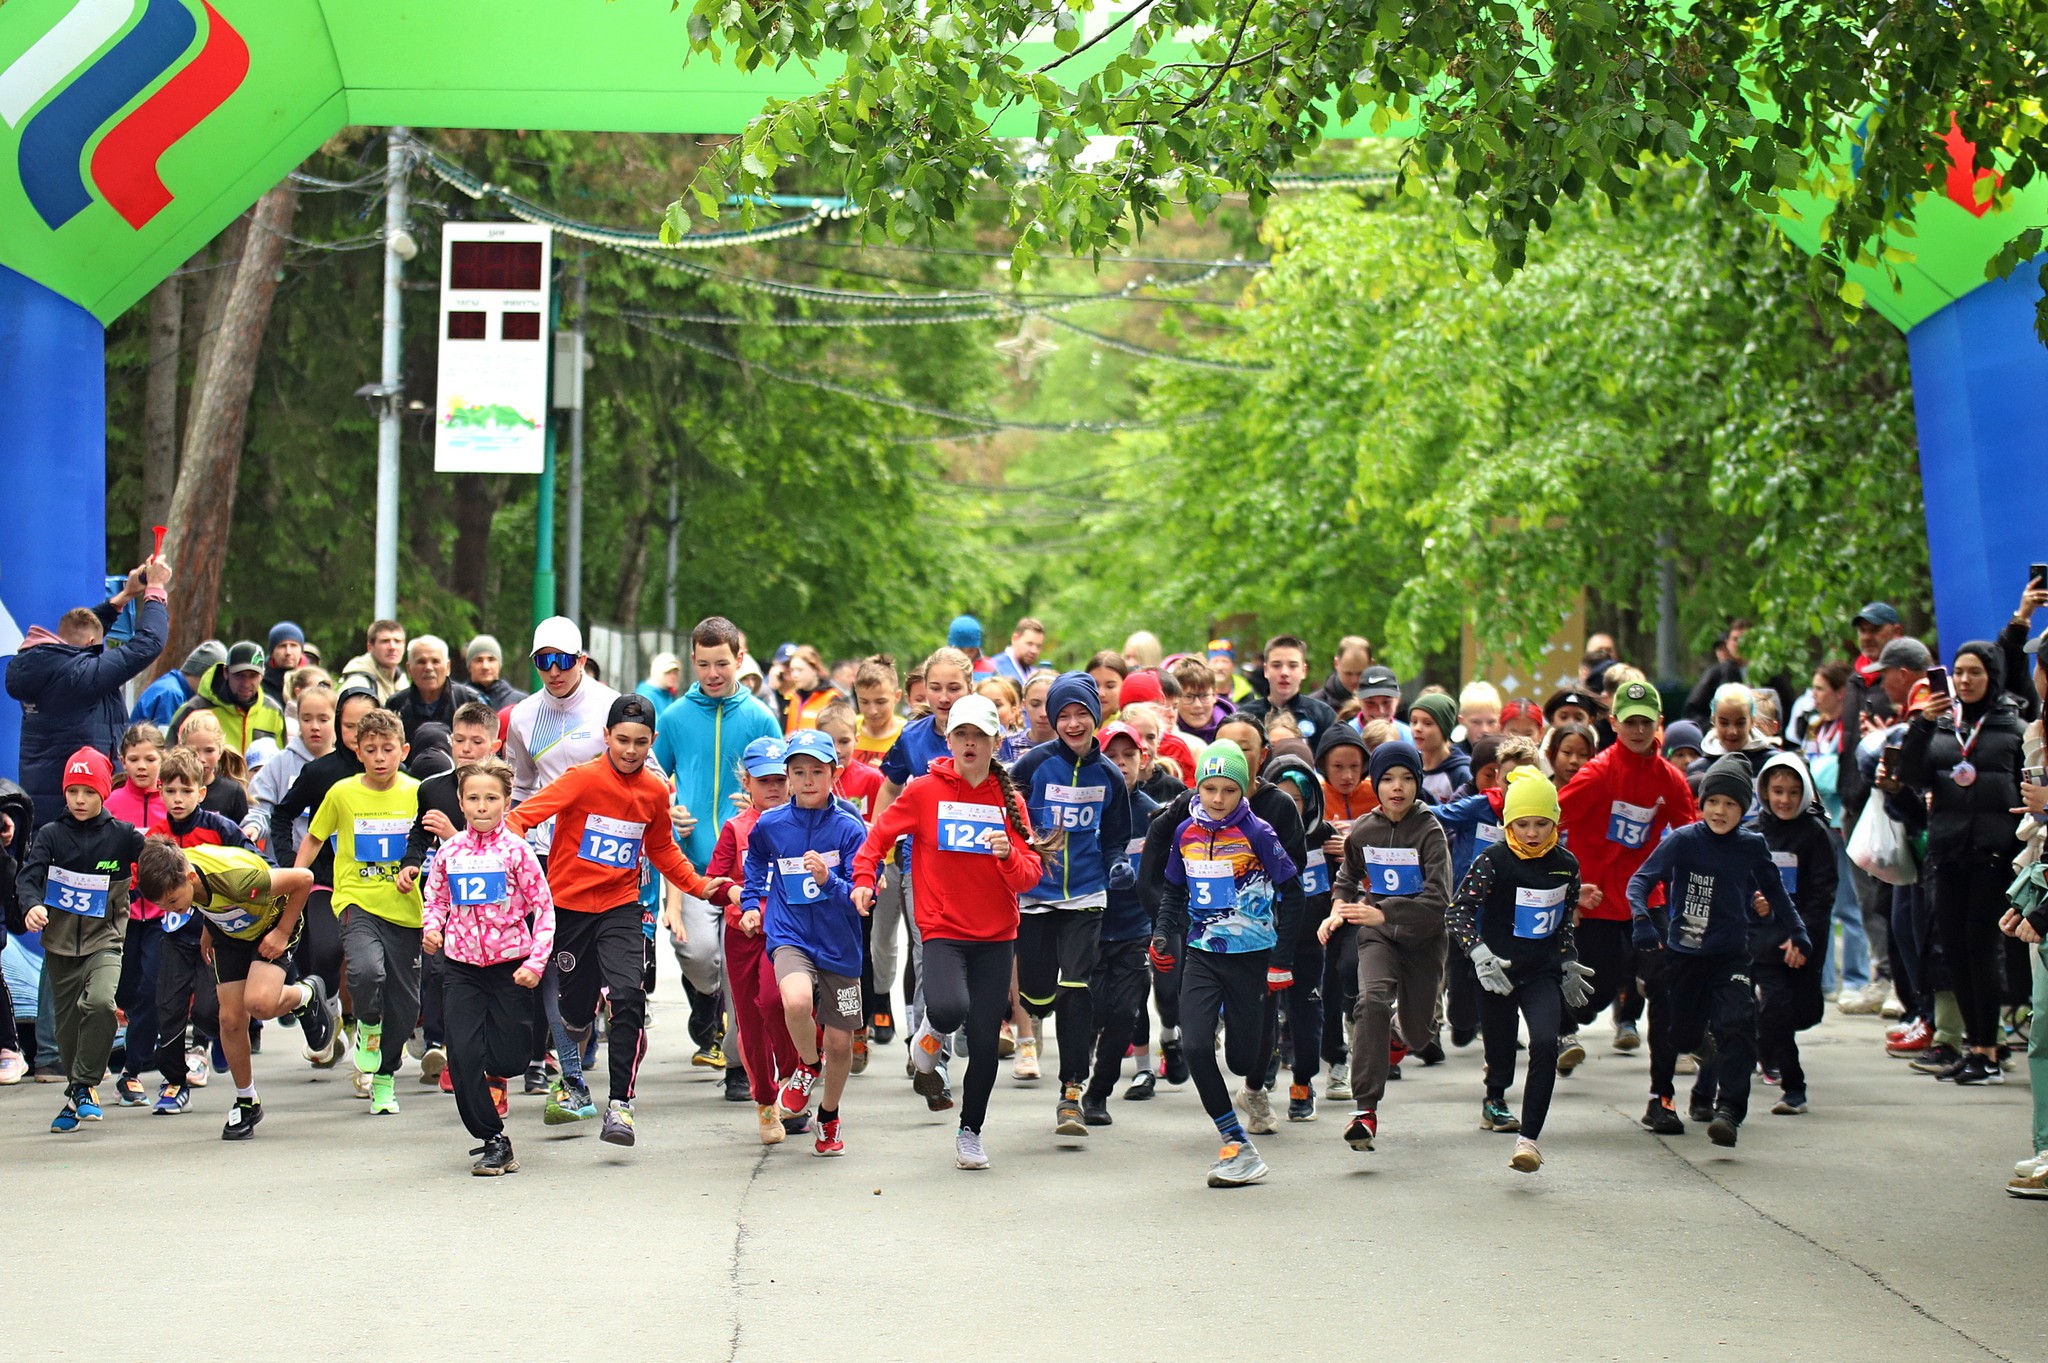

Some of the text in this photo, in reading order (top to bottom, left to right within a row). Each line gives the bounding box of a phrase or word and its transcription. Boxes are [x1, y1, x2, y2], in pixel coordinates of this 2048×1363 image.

[1051, 806, 1094, 828] 150
[378, 837, 389, 858] 1
[944, 823, 993, 850] 124
[590, 835, 633, 864] 126
[457, 876, 487, 901] 12
[802, 876, 821, 899] 6
[1383, 868, 1399, 891] 9
[1687, 883, 1713, 898] IS THE
[1689, 871, 1715, 887] TODAY
[58, 888, 92, 912] 33
[1195, 882, 1212, 905] 3
[1684, 900, 1710, 918] EVER
[1532, 909, 1557, 935] 21
